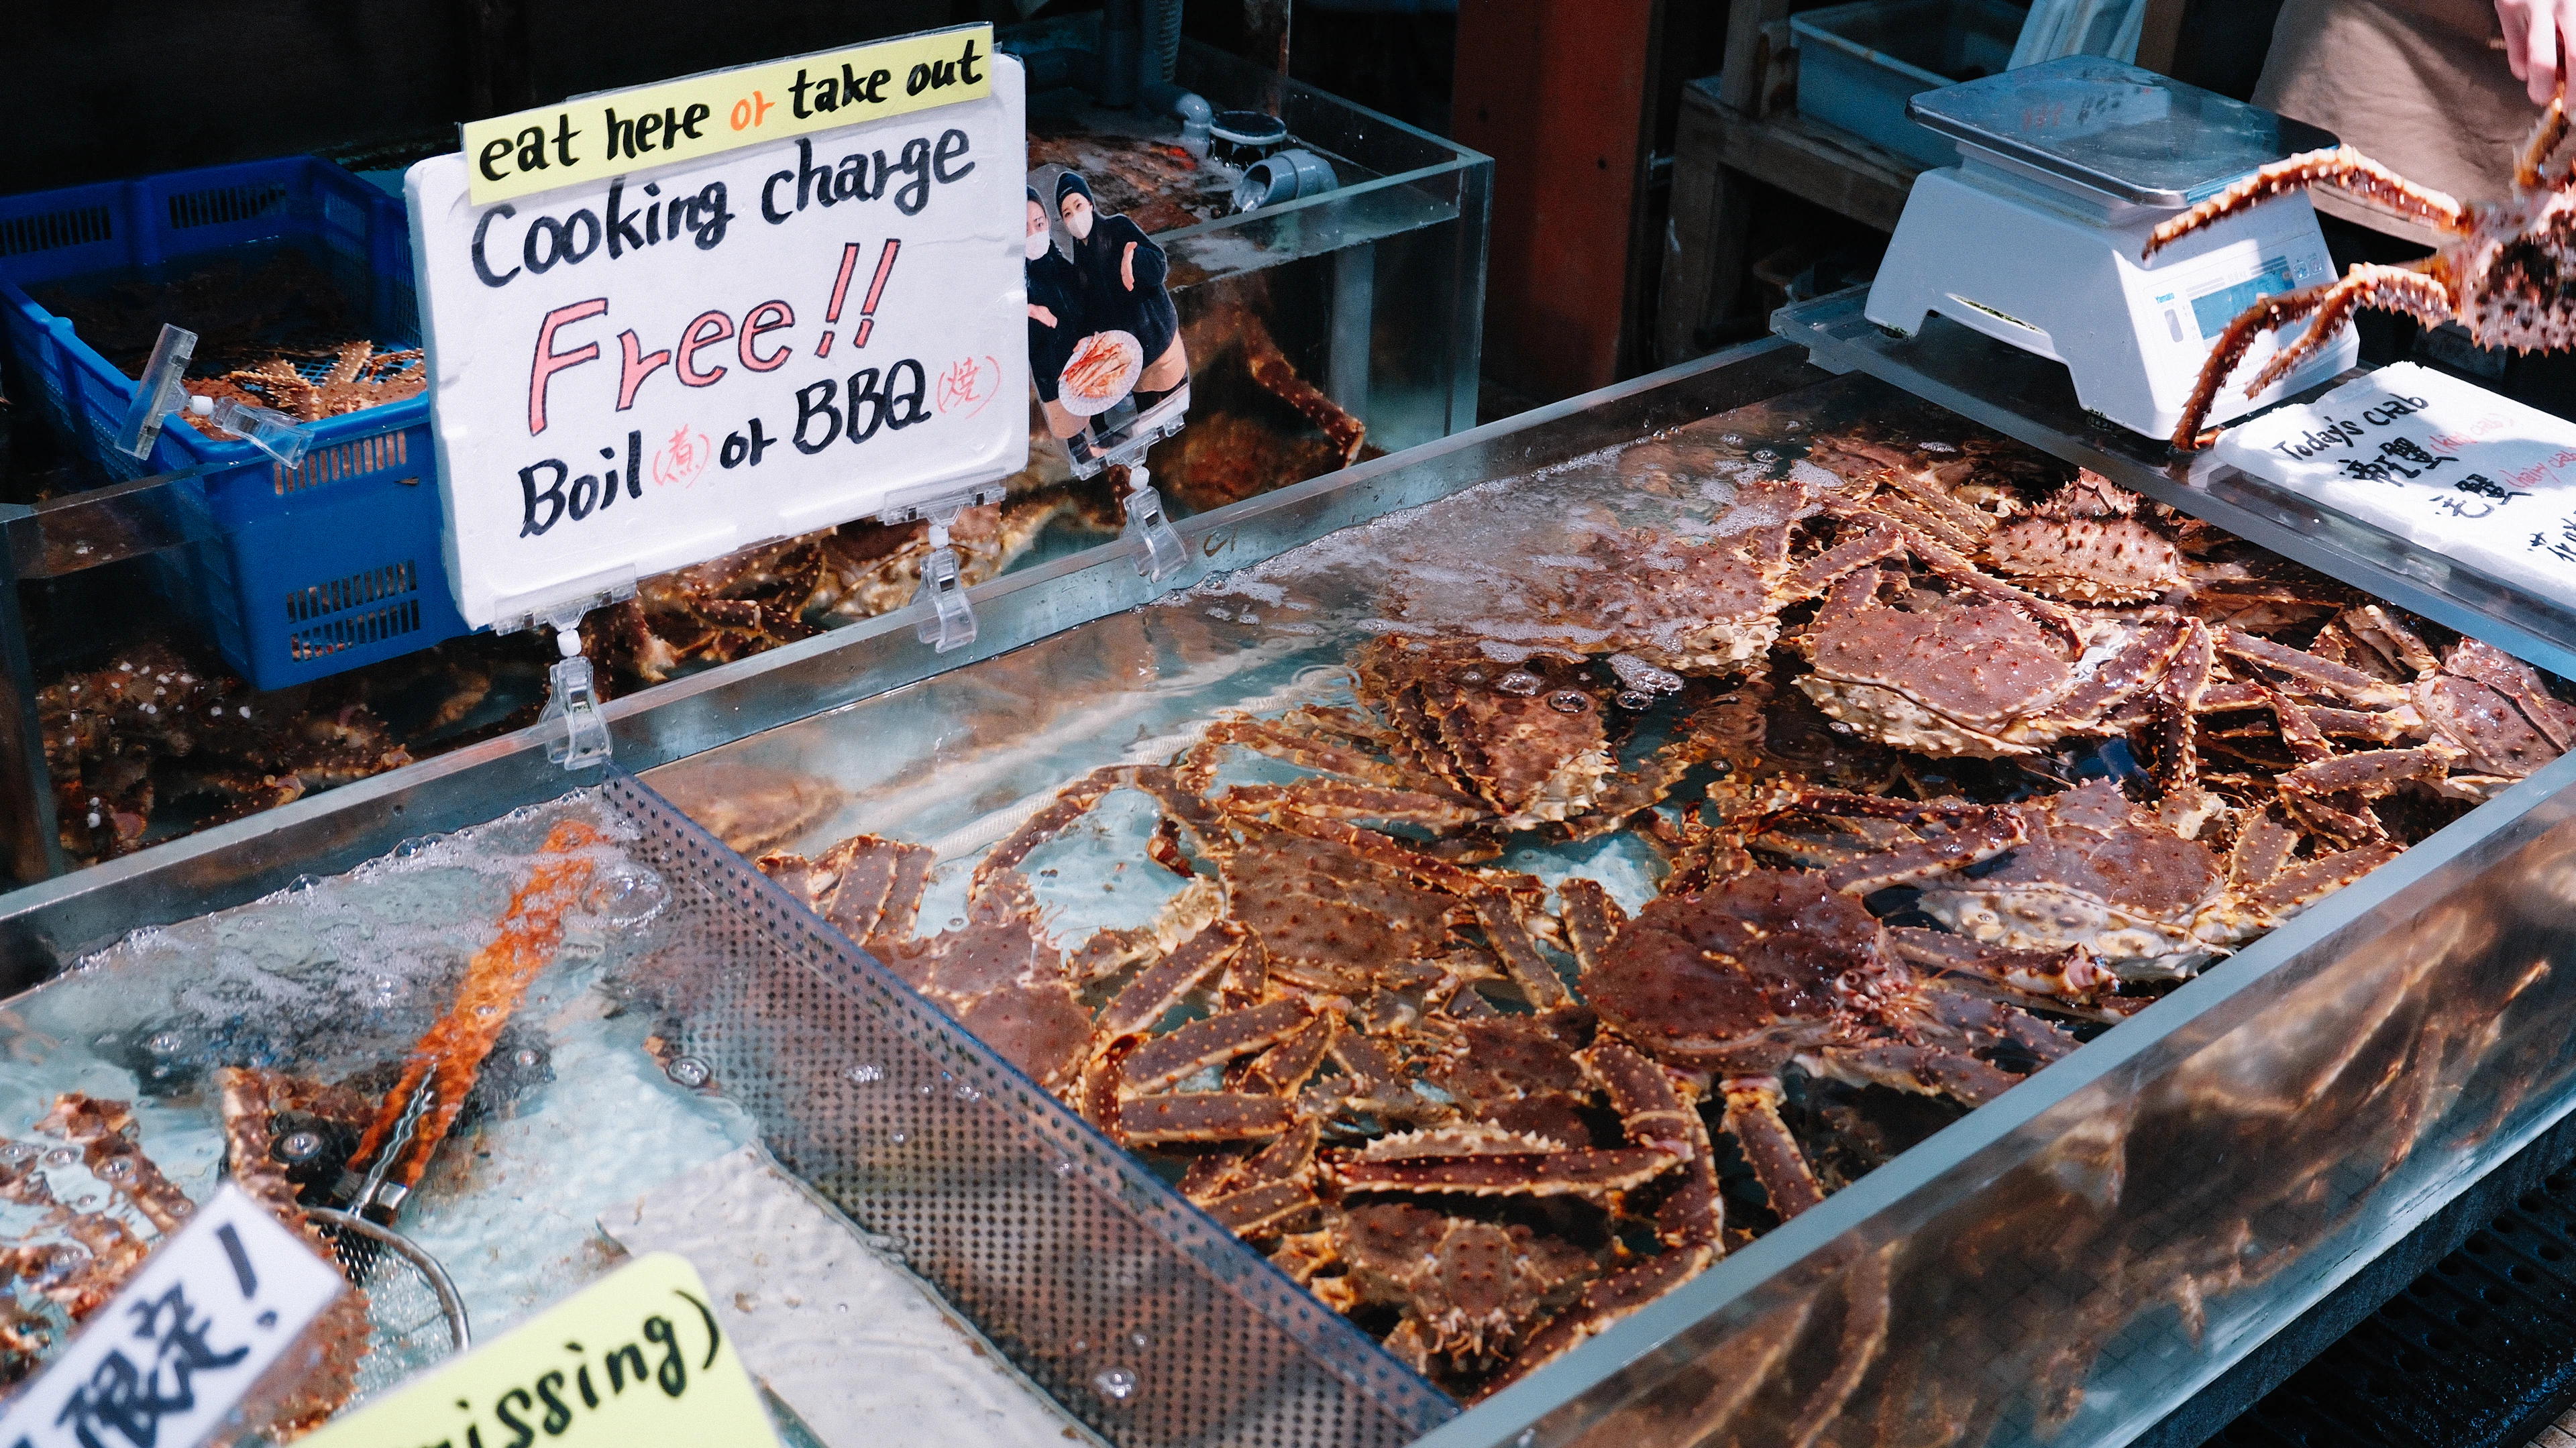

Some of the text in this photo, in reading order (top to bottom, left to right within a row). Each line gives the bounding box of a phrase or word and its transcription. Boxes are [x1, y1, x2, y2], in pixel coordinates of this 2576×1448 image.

[479, 39, 983, 181] eat here or take out
[472, 129, 975, 286] Cooking charge
[720, 418, 777, 469] or
[793, 359, 932, 455] BBQ
[2272, 415, 2365, 461] Today's
[421, 1288, 721, 1448] issing)
